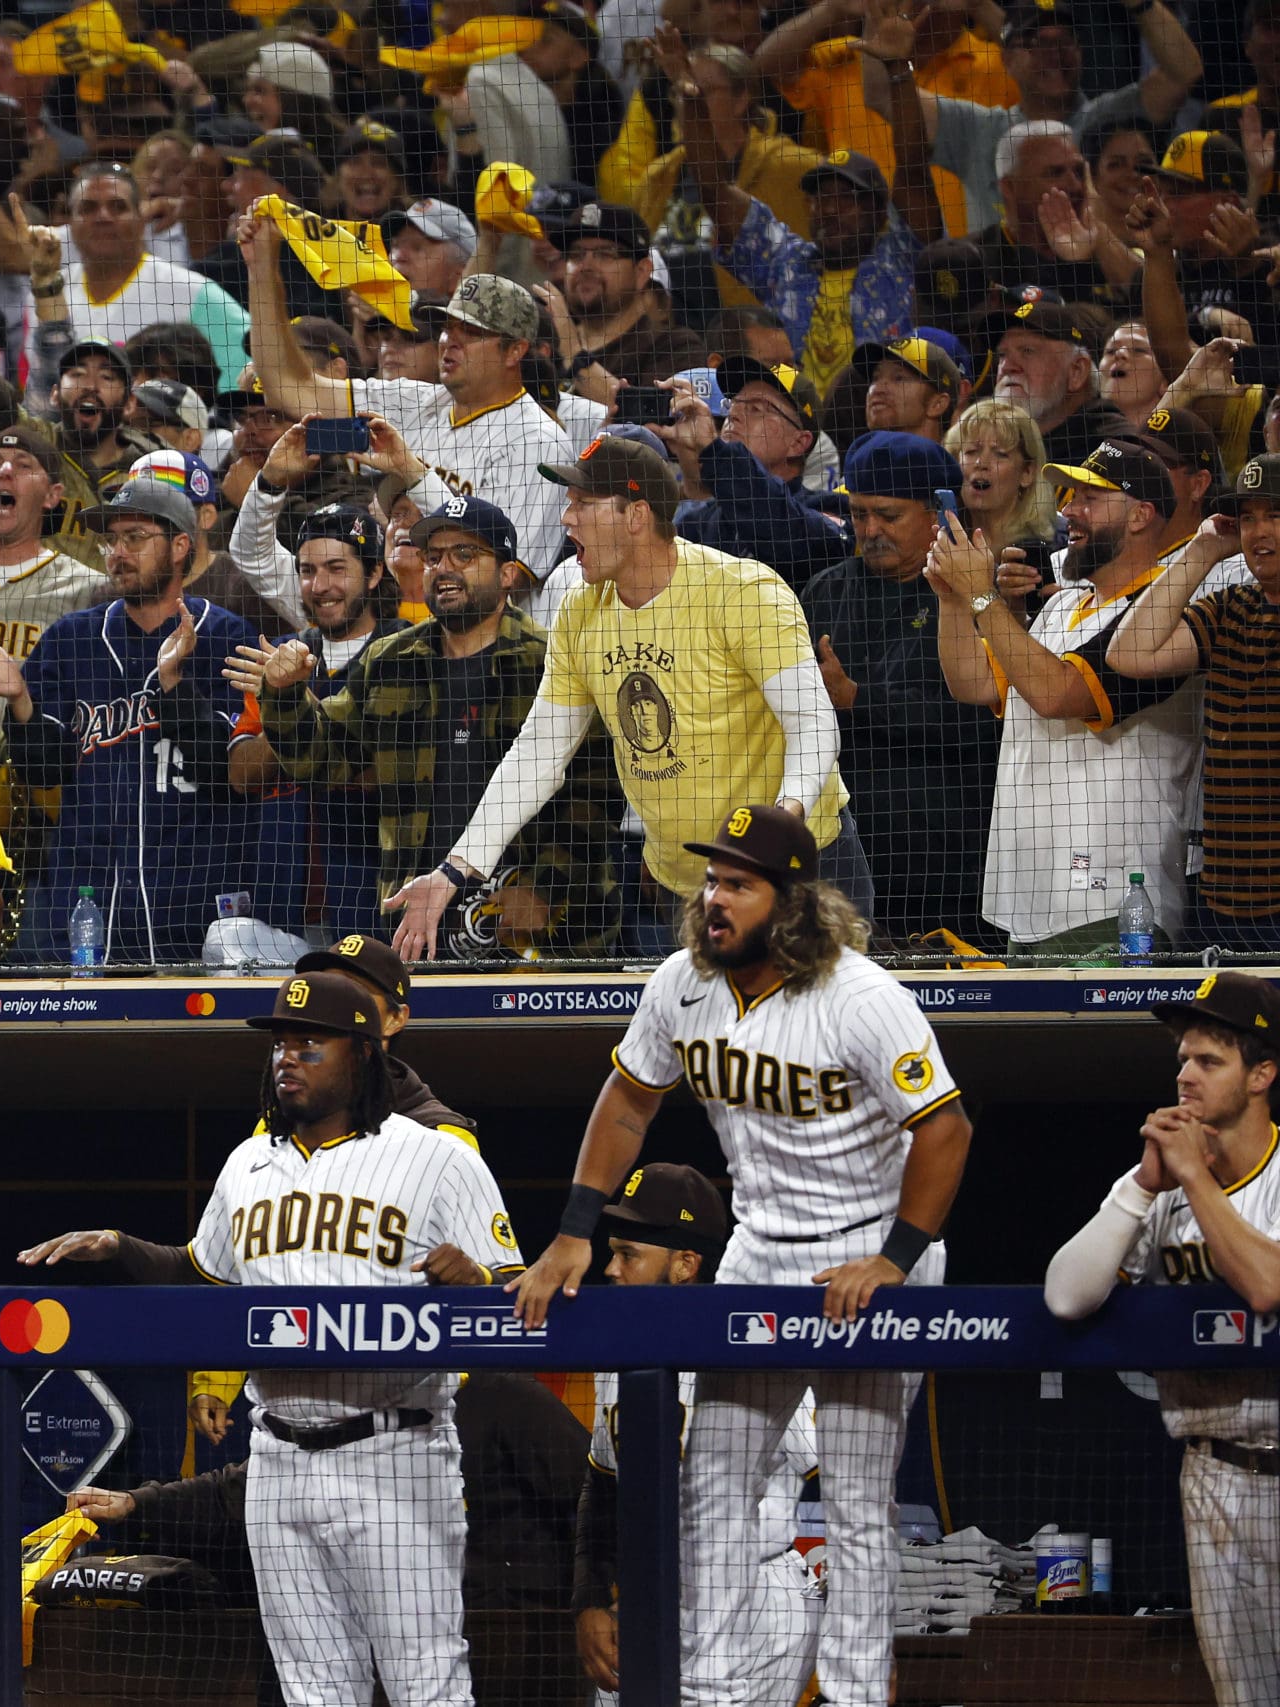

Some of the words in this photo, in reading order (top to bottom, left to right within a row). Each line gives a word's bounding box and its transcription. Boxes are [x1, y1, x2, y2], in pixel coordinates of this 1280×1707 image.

[602, 641, 675, 676] JAKE
[630, 759, 688, 783] CRONENWORTH
[727, 807, 753, 838] SD
[338, 934, 365, 957] SD
[3, 999, 37, 1014] enjoy
[38, 998, 62, 1012] the
[64, 998, 98, 1012] show.
[286, 979, 311, 1009] SD
[517, 990, 639, 1010] POSTSEASON
[912, 987, 956, 1006] NLDS
[957, 991, 992, 1001] 2022
[1108, 988, 1144, 1004] enjoy
[1147, 986, 1175, 1001] the
[1177, 986, 1198, 1001] sho
[232, 1191, 408, 1269] PADRES
[315, 1303, 441, 1352] NLDS
[780, 1313, 867, 1348] enjoy
[871, 1309, 921, 1340] the
[925, 1309, 1010, 1341] show.
[46, 1414, 101, 1430] Extreme
[50, 1567, 146, 1592] PADRES
